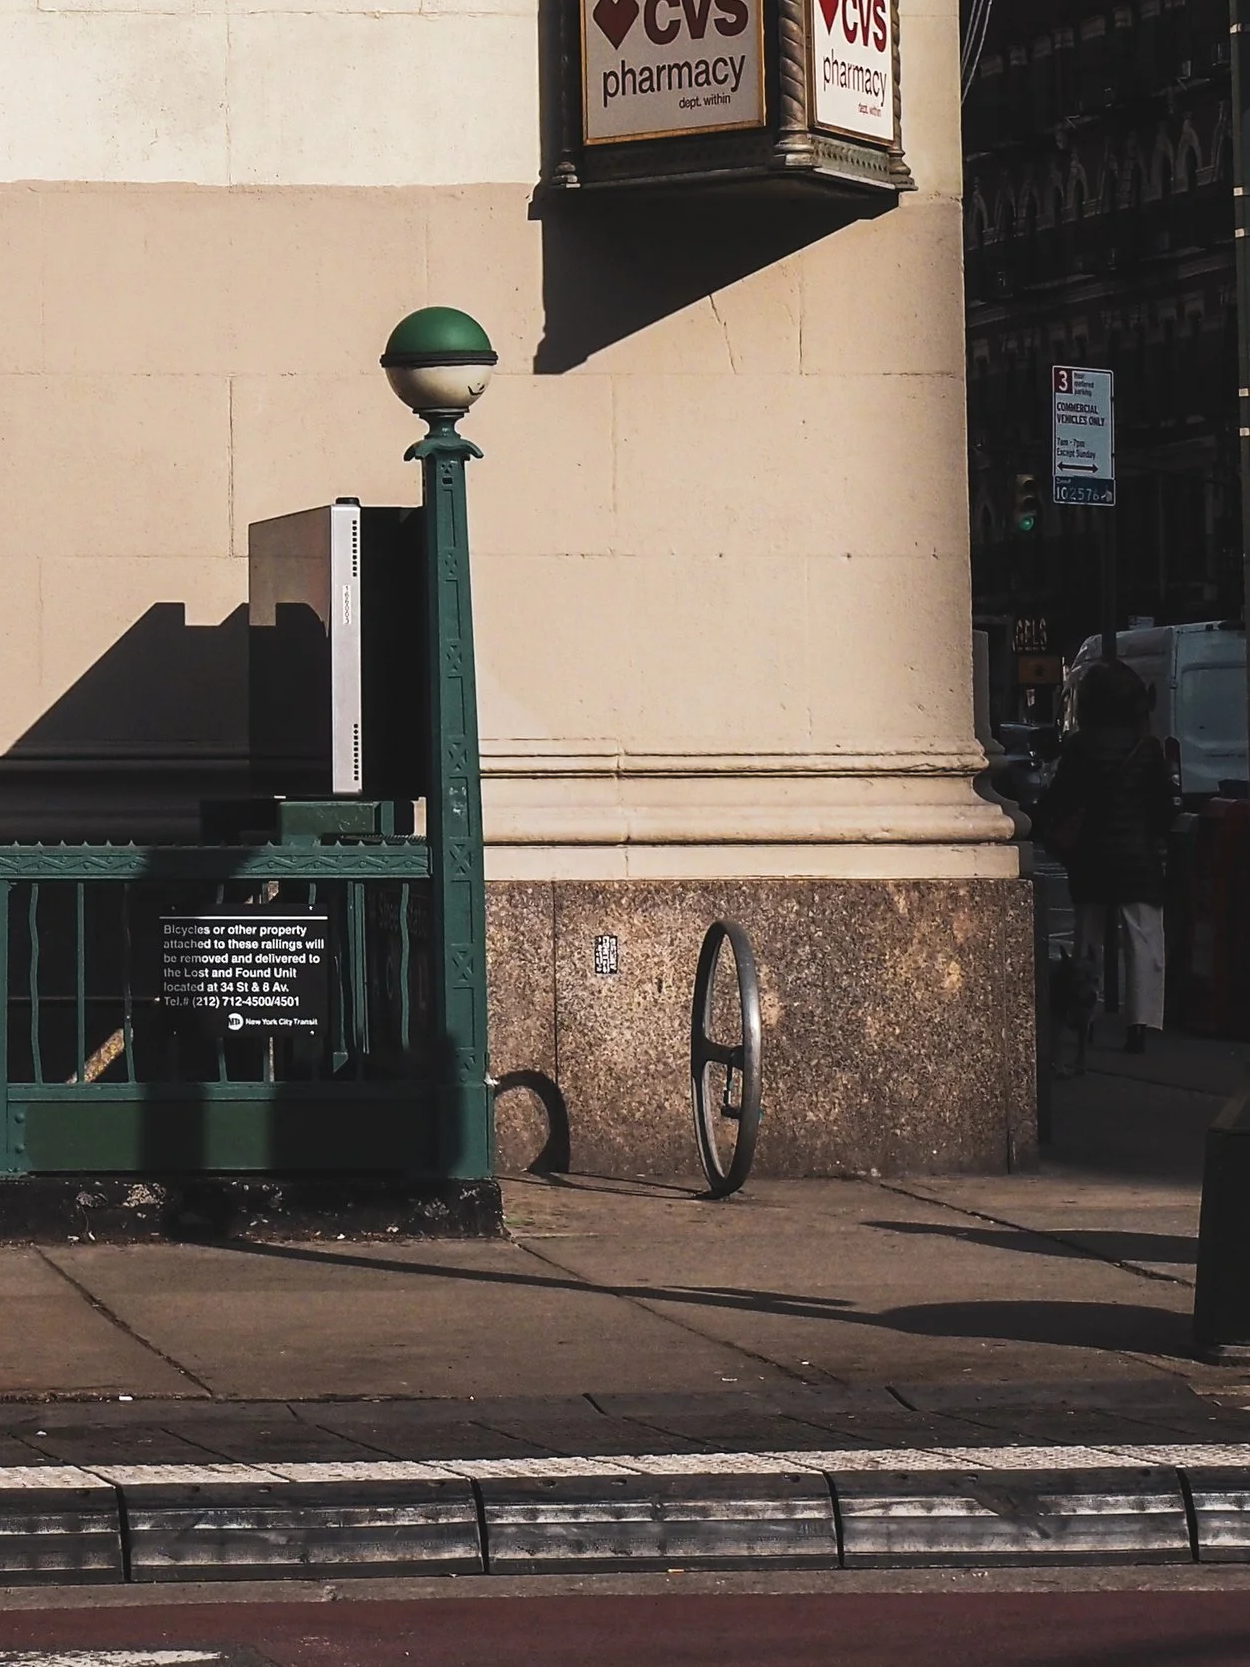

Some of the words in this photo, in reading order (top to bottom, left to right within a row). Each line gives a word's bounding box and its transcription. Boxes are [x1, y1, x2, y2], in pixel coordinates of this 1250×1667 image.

[603, 55, 746, 108] pharmacy
[823, 49, 887, 107] pharmacy
[679, 96, 702, 110] dept.
[703, 93, 731, 107] within
[1059, 370, 1068, 391] 3
[1057, 402, 1099, 414] COMMERCIAL
[1057, 414, 1087, 425] VEHICLES
[1089, 416, 1105, 426] ONLY
[1076, 449, 1096, 460] Sunday
[164, 924, 210, 936] Bicycles
[213, 926, 225, 934] or
[228, 924, 257, 934] other
[260, 925, 307, 937] property
[163, 939, 211, 949] attached
[214, 939, 225, 949] to
[228, 939, 258, 949] these
[261, 939, 302, 951] railings
[305, 939, 324, 949] will
[164, 952, 177, 963] be
[180, 953, 228, 963] removed
[231, 953, 252, 963] and
[255, 953, 306, 963] delivered
[309, 953, 320, 963] to
[164, 967, 181, 977] the
[184, 967, 209, 977] Lost
[212, 967, 232, 977] and
[235, 967, 271, 977] Found
[274, 967, 297, 978] Unit
[164, 982, 204, 992] located
[207, 982, 218, 992] at
[220, 982, 234, 992] 34
[236, 982, 249, 992] St
[251, 982, 260, 992] &
[262, 982, 269, 992] 8
[272, 982, 289, 992] Av.
[164, 996, 189, 1006] Tel.#
[192, 996, 220, 1009] (212)
[222, 996, 299, 1007] 712-4500/4501
[278, 1018, 293, 1026] City
